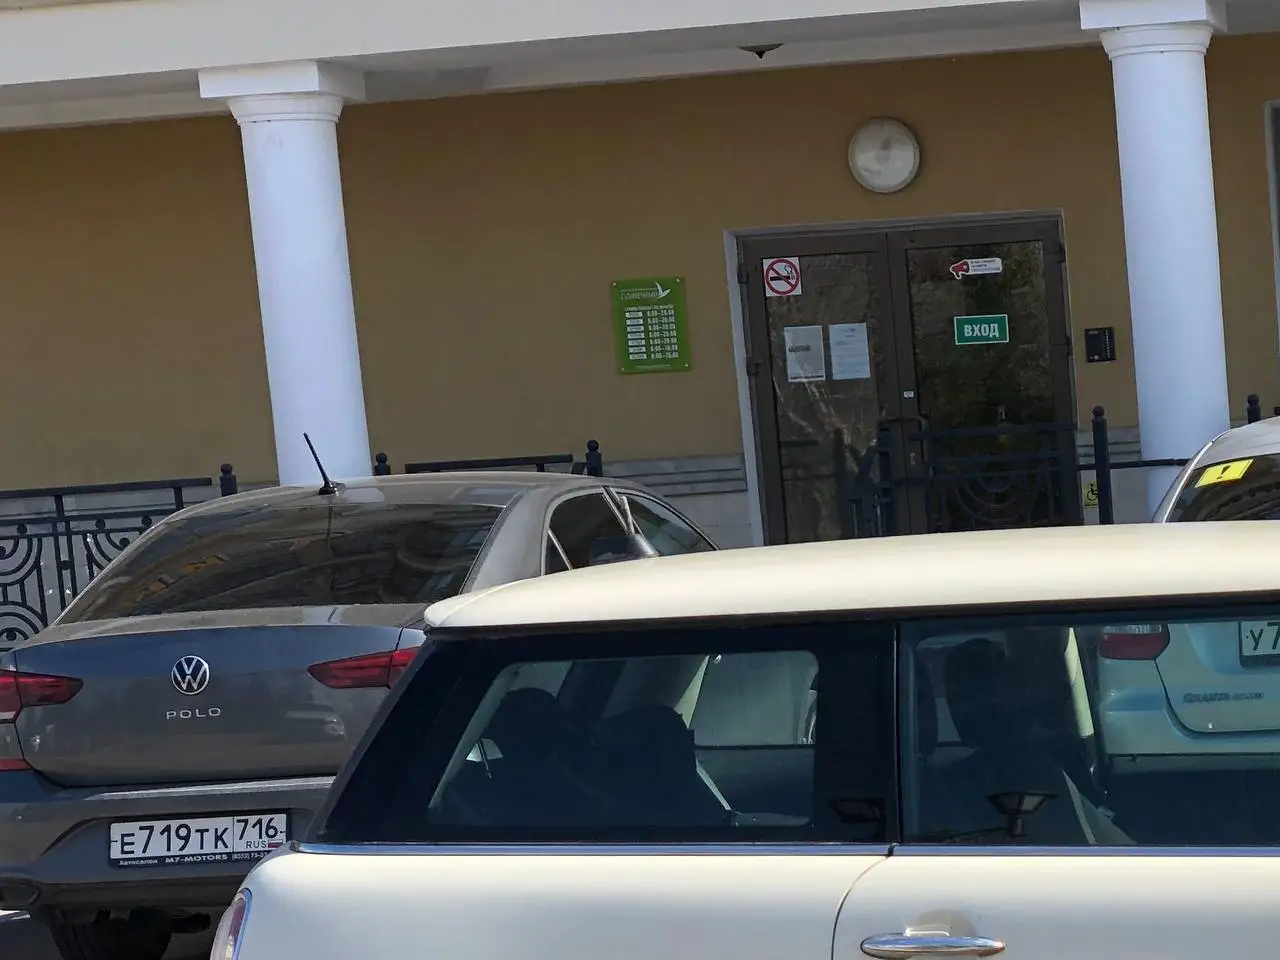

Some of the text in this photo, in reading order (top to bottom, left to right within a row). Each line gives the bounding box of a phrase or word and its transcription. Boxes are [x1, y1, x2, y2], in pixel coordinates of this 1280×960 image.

[963, 323, 1000, 338] ВХОД
[166, 707, 221, 720] POLO
[236, 817, 279, 841] 716
[245, 840, 267, 849] RUS
[165, 853, 229, 864] M7-MOTORS
